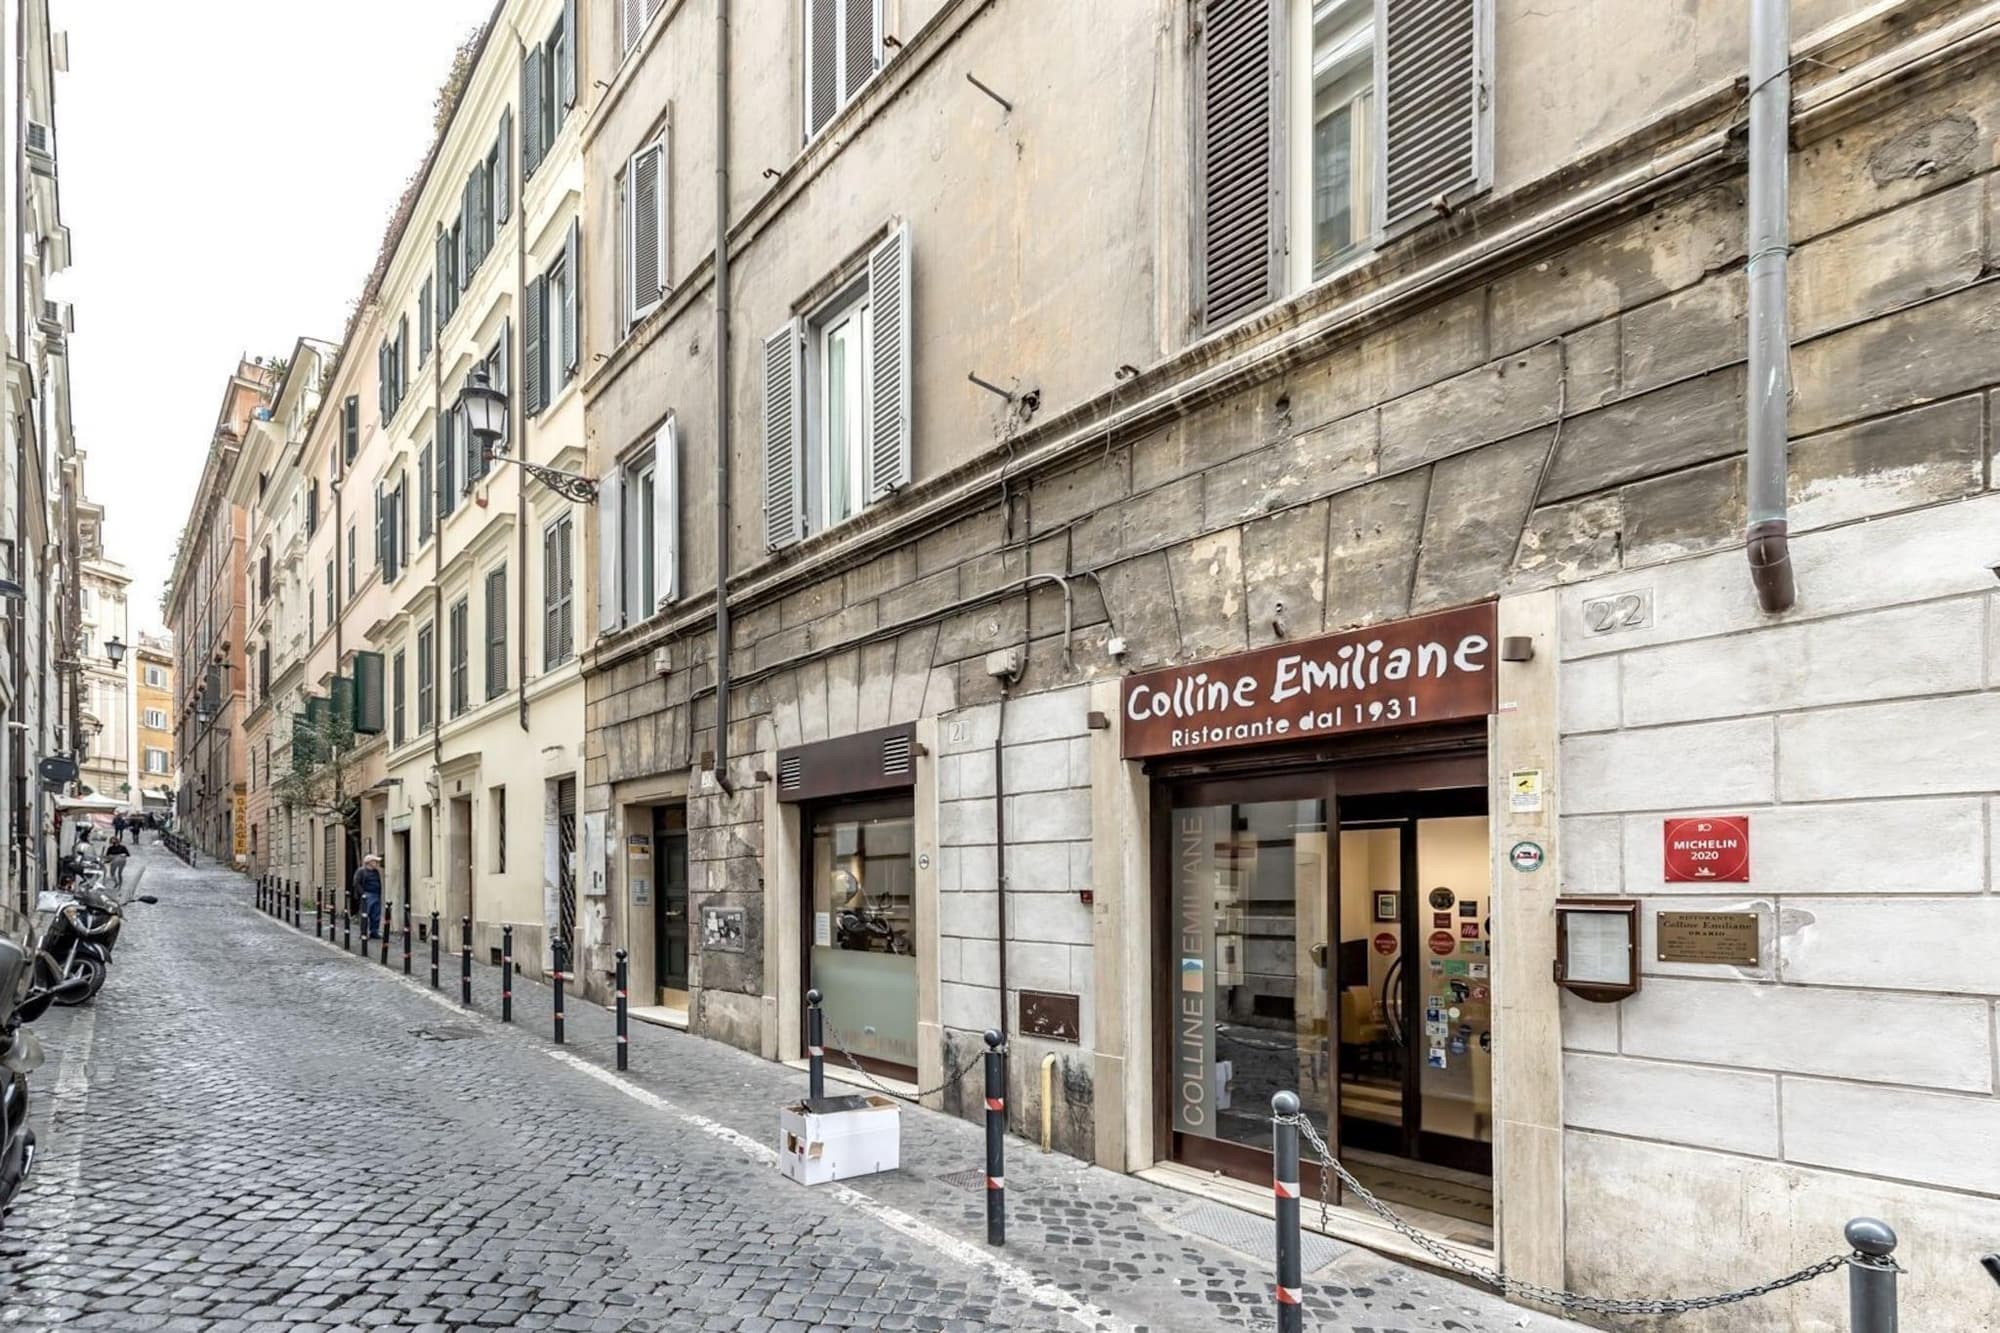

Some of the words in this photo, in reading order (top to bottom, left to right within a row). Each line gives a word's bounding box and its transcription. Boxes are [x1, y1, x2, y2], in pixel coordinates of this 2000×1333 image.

[1592, 594, 1645, 632] 22
[1127, 673, 1258, 721] Colline
[1269, 634, 1489, 703] Emiliane
[1172, 716, 1290, 747] Ristorante
[1299, 706, 1342, 731] dal
[1354, 696, 1417, 723] 1931
[1673, 839, 1738, 850] MICHELIN
[1690, 851, 1719, 861] 2020
[1182, 816, 1203, 954] EMILIANE
[1183, 998, 1204, 1126] COLLINE
